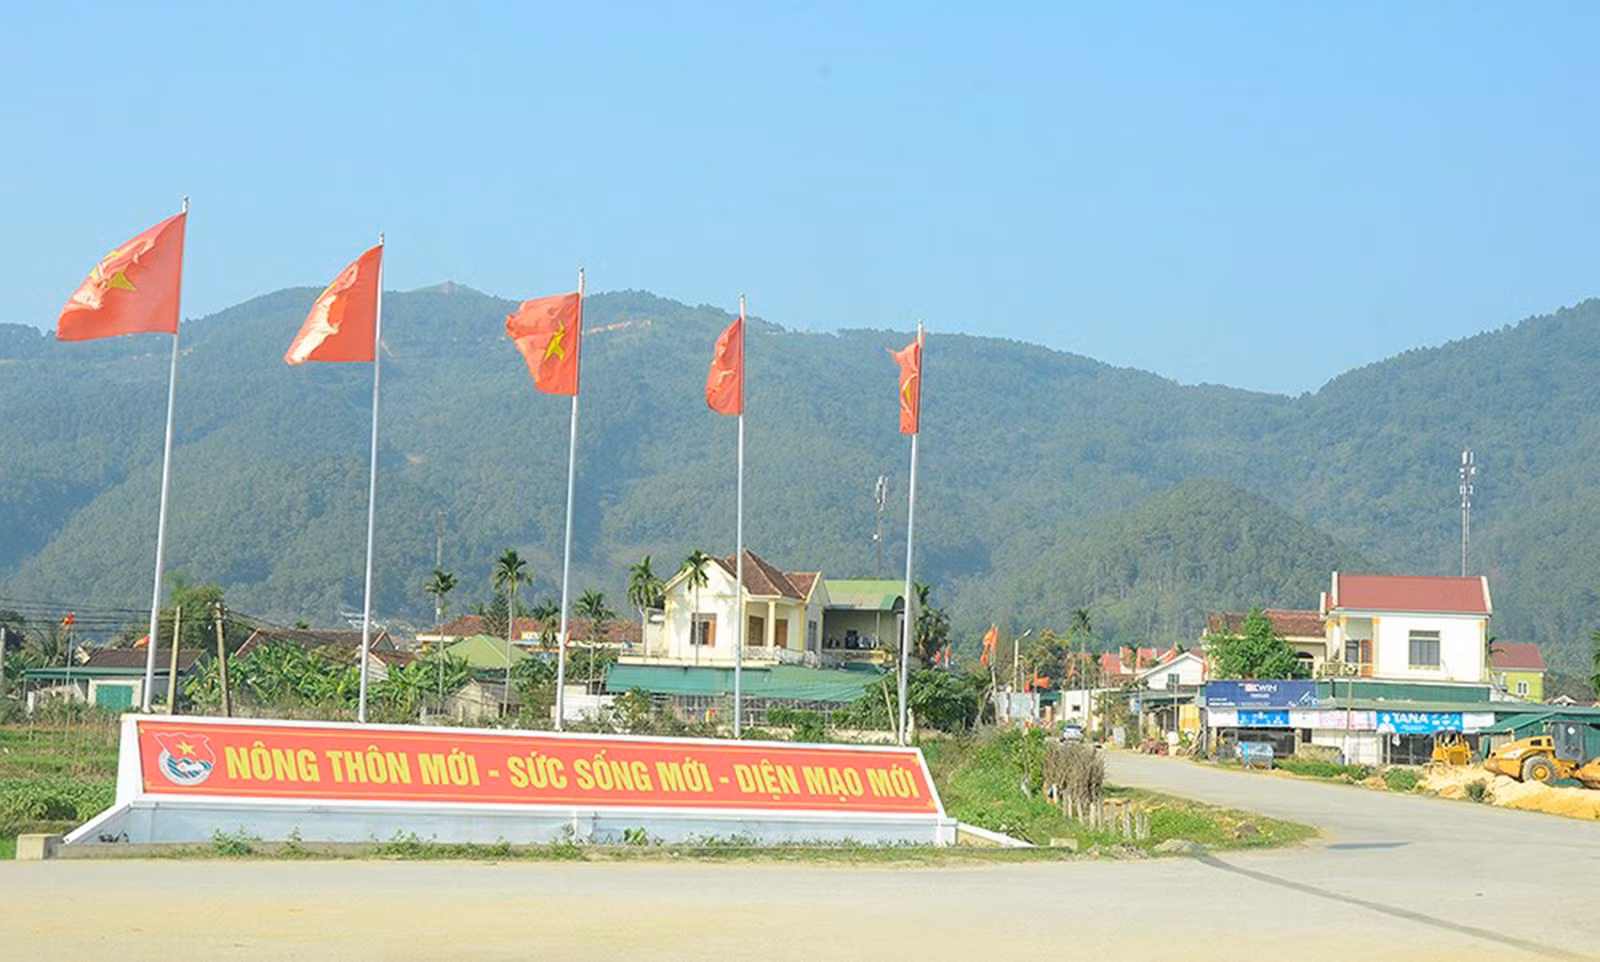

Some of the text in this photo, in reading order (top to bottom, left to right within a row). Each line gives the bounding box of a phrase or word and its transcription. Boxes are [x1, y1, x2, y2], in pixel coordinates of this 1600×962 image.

[1392, 712, 1429, 724] TANA
[224, 740, 320, 783] NÔNG
[325, 744, 412, 785] THÔN
[417, 747, 481, 787] MỚI
[506, 751, 568, 790] SỨC
[574, 748, 654, 792] SỐNG
[655, 756, 714, 793] MỚI
[733, 758, 801, 801] DIỆN
[801, 765, 865, 802] MẠO
[866, 763, 921, 799] MỚI
